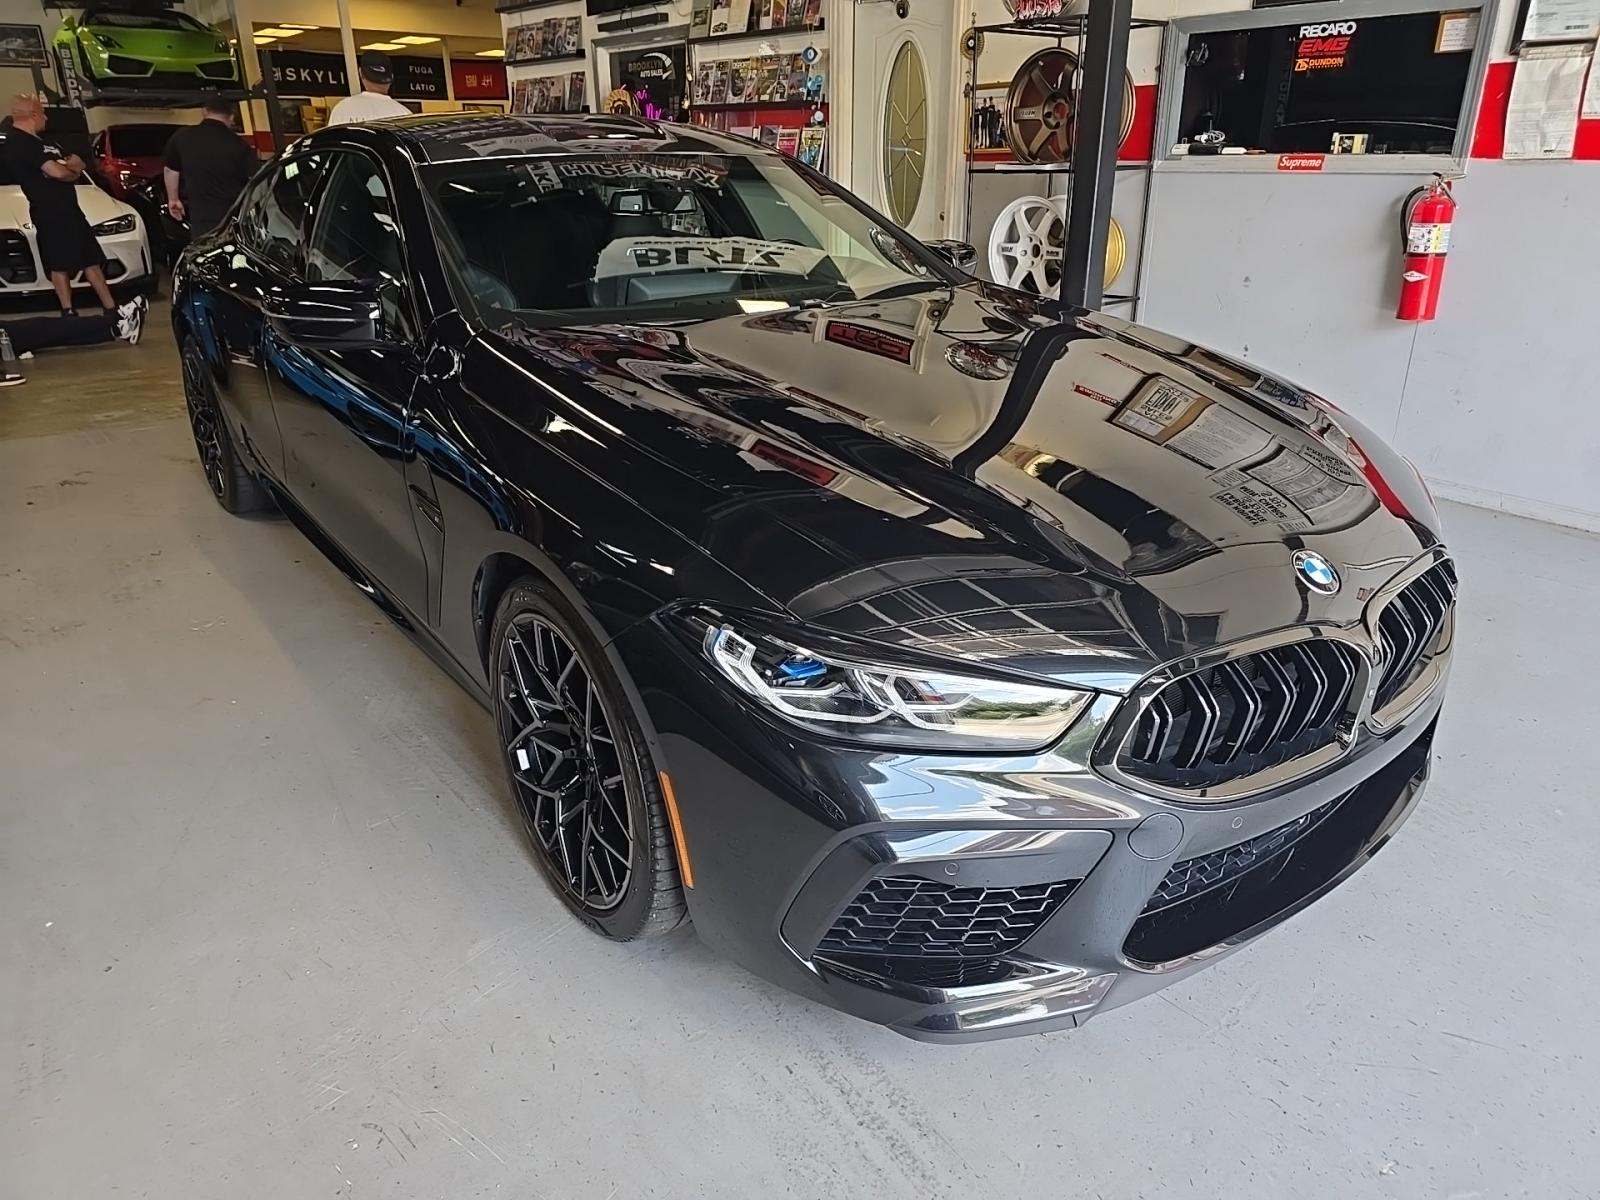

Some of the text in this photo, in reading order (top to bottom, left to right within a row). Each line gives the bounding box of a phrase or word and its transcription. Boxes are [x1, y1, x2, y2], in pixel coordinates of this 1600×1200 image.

[1299, 21, 1357, 38] RECARO
[628, 60, 664, 73] BROOKLYN
[640, 68, 663, 78] AUTO SALES
[409, 82, 436, 92] LATIO
[1280, 156, 1322, 170] Supreme
